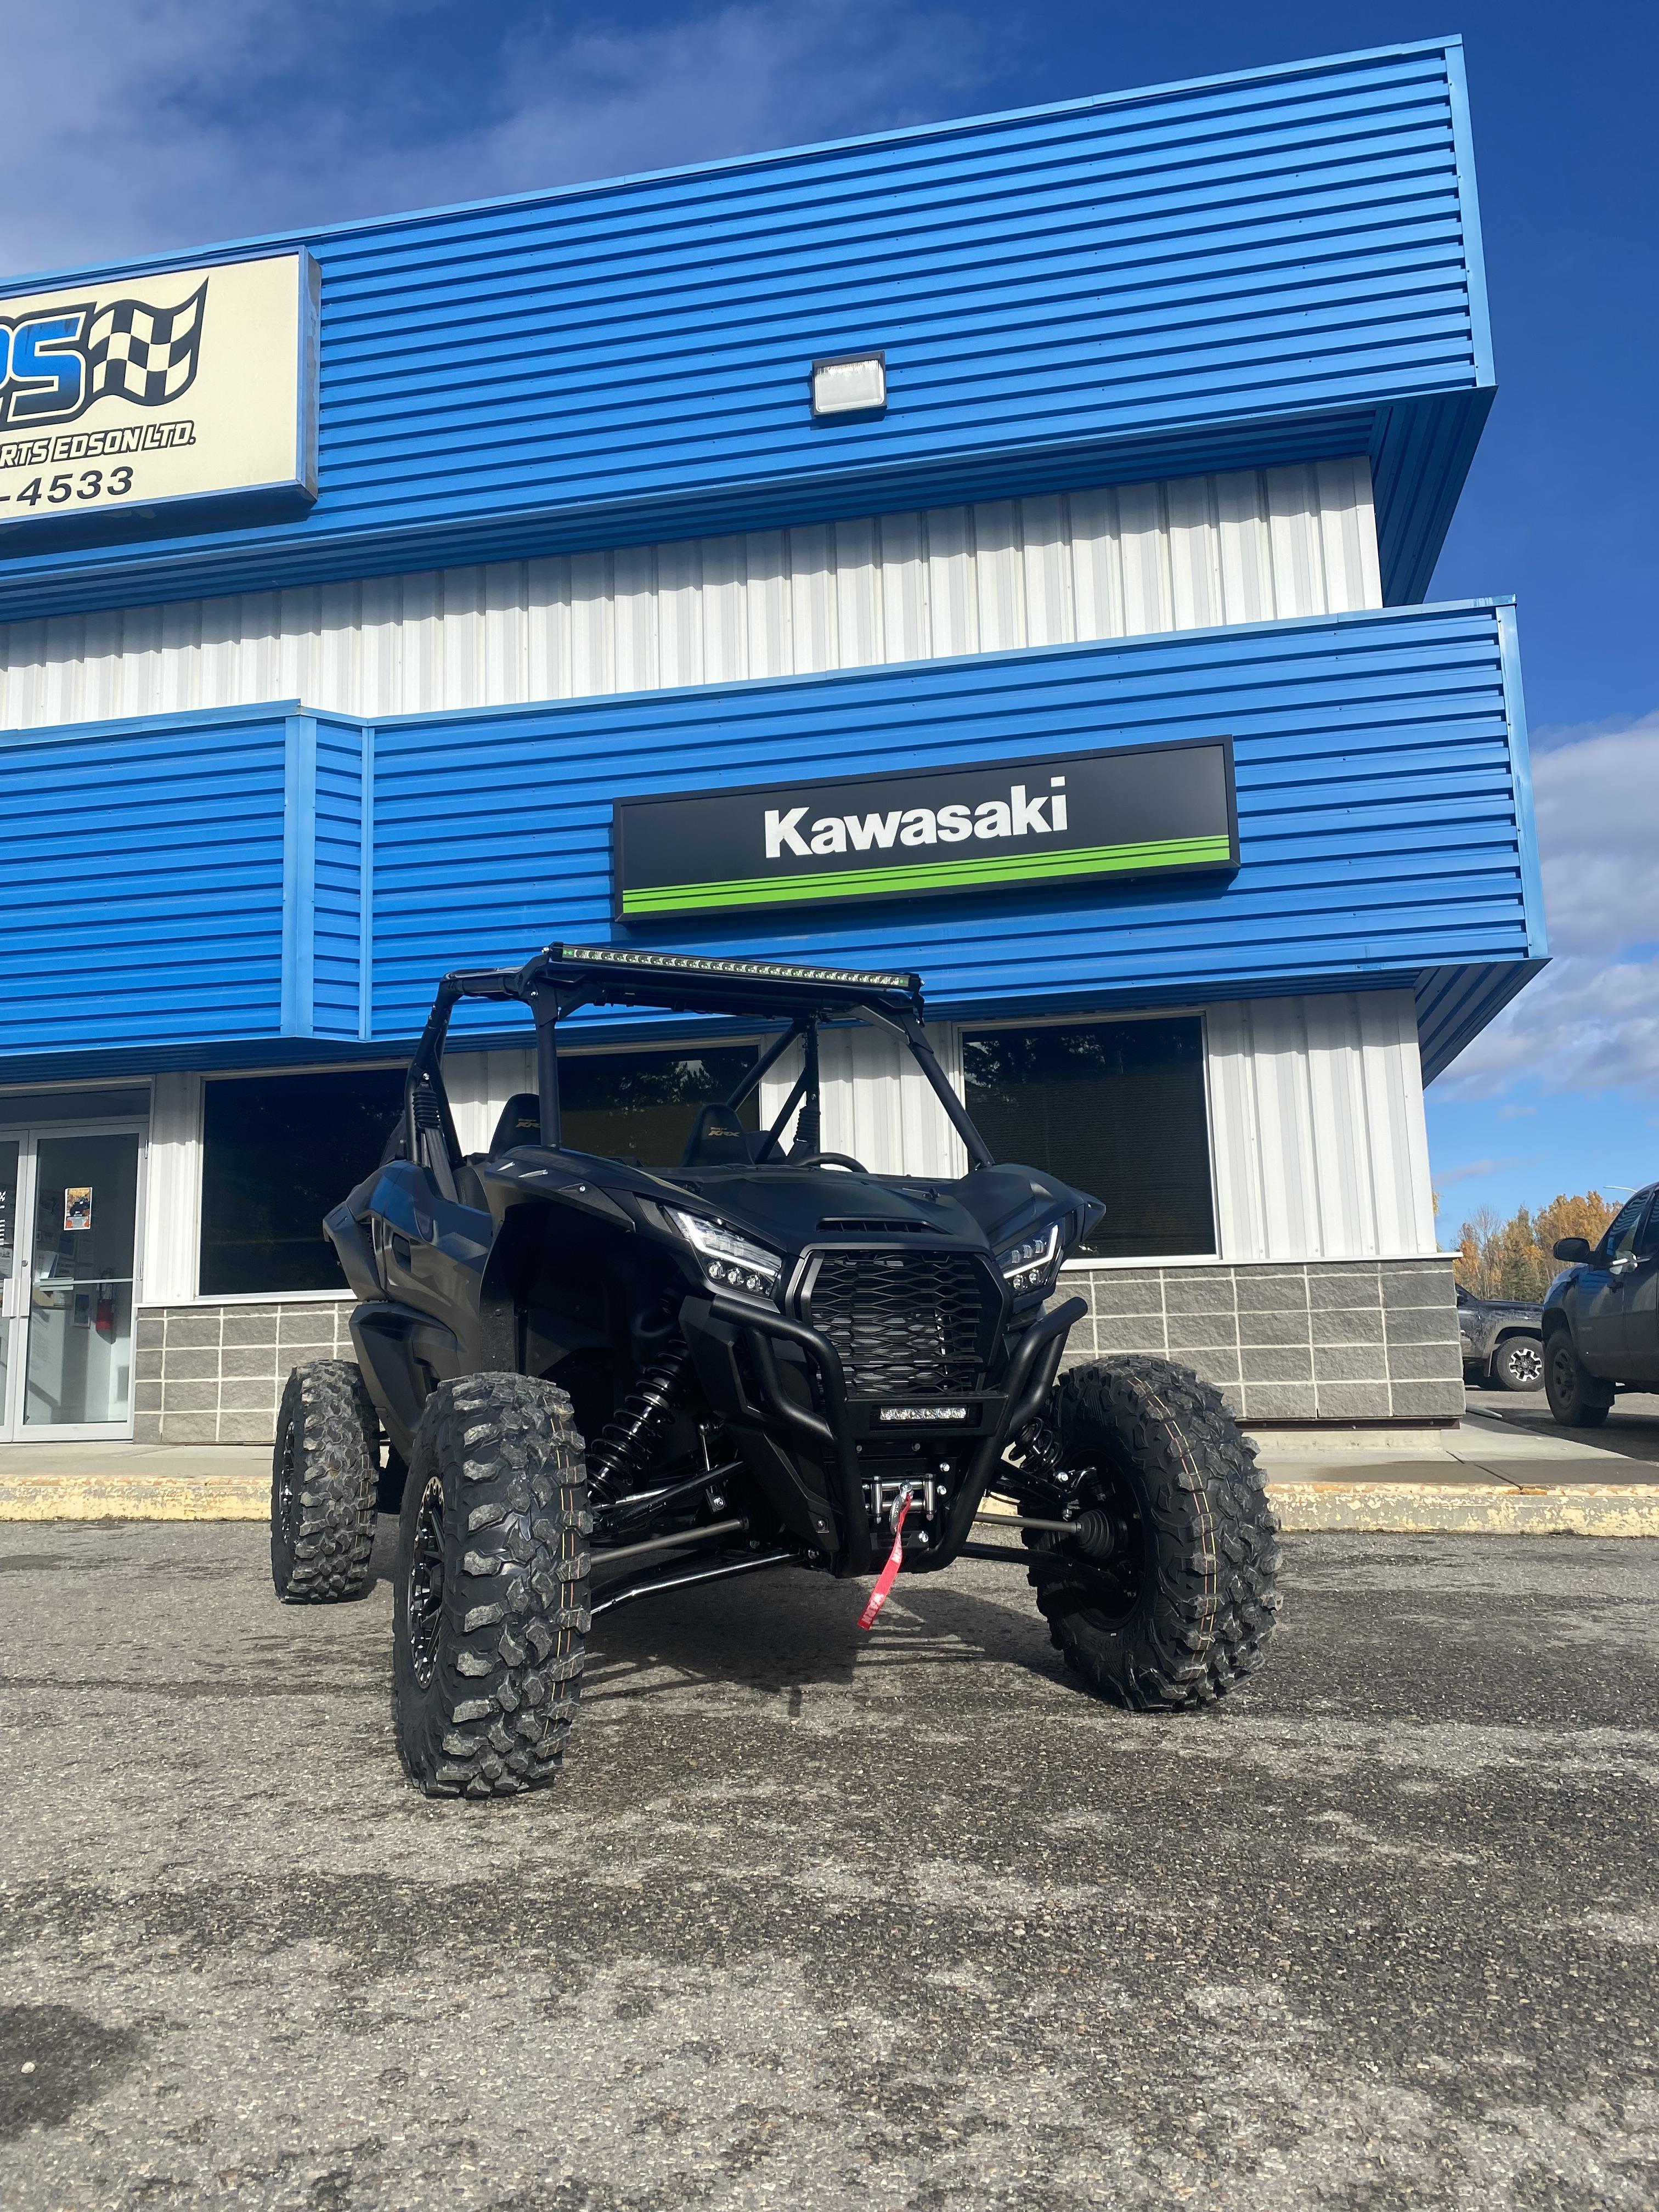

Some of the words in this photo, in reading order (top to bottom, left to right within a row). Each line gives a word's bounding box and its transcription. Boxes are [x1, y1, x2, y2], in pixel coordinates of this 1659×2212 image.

[0, 303, 95, 431] S
[51, 426, 144, 462] EDSON
[142, 420, 196, 450] LTD.
[764, 776, 1068, 858] Kawasaki
